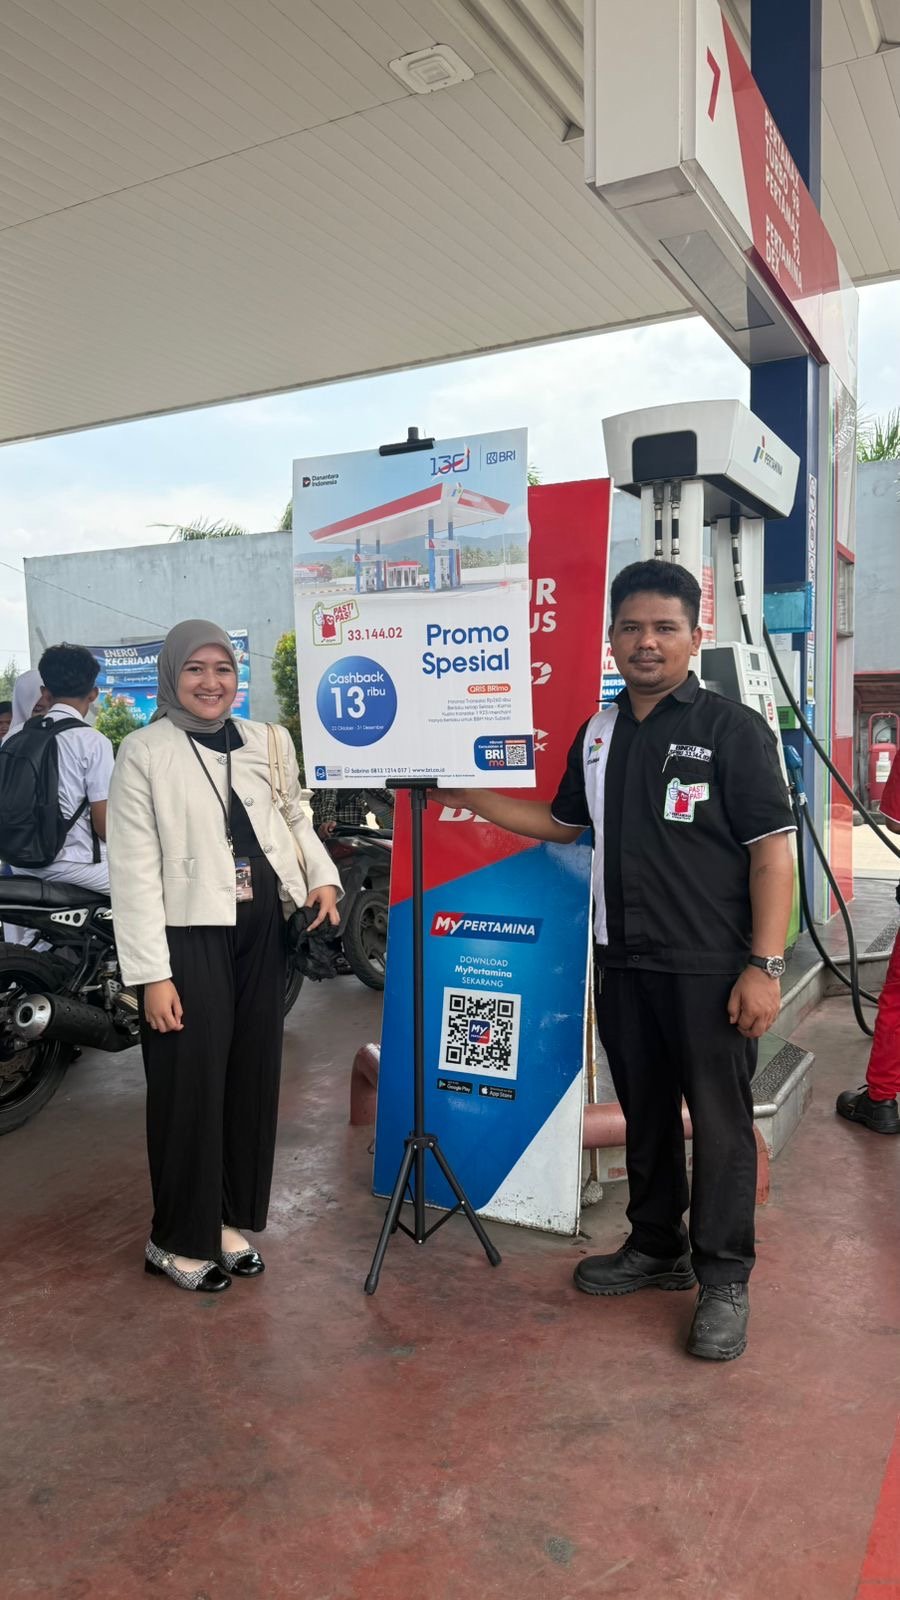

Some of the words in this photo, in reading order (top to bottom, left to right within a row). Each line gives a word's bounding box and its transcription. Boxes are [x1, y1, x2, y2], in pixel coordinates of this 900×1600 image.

[765, 107, 800, 196] PERTAMAX
[765, 134, 788, 195] TURBO
[765, 164, 800, 246] PERTAMAX
[766, 214, 803, 293] PERTAMINA
[766, 239, 780, 280] DEX
[499, 450, 516, 462] BRI
[348, 626, 403, 641] 33.144.02
[426, 623, 510, 646] Promo
[103, 648, 138, 658] ENERGI
[105, 655, 158, 667] KECERIAAN
[422, 648, 510, 679] Spesial
[328, 671, 384, 684] Cashback
[469, 685, 486, 693] QRIS
[487, 684, 509, 693] BRImo
[331, 686, 366, 719] 13
[367, 687, 386, 697] ribu
[485, 749, 504, 760] BRI
[460, 955, 508, 967] DOWNLOAD
[454, 965, 512, 978] MyPertamina
[462, 976, 504, 988] SEKARANG
[471, 1024, 488, 1036] My
[447, 1083, 461, 1092] Google
